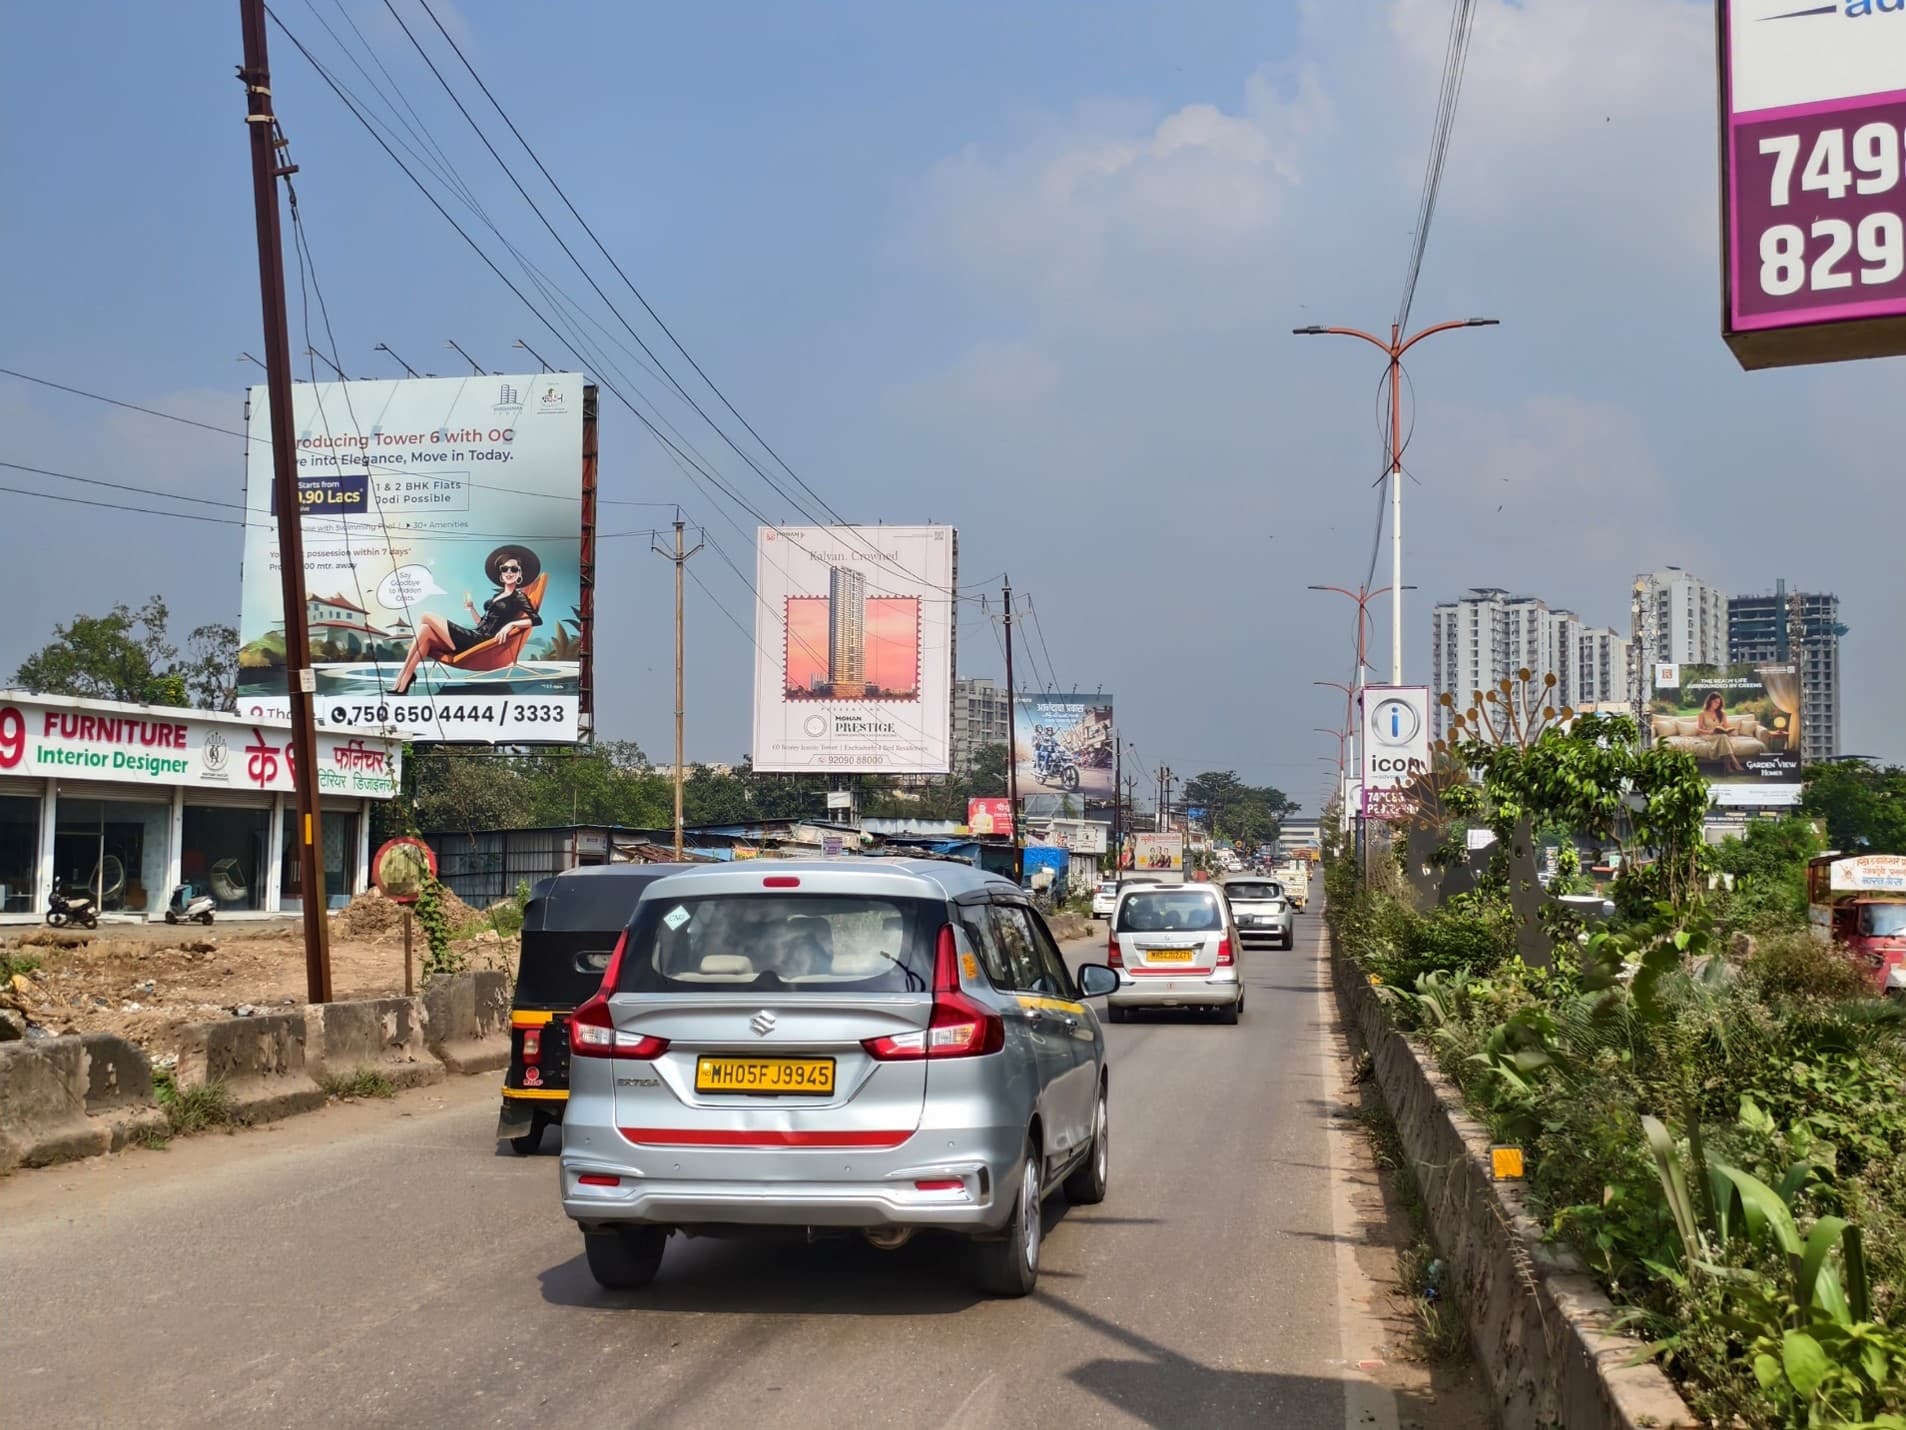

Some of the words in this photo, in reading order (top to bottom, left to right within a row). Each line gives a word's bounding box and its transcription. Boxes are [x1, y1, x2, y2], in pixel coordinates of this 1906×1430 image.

[374, 431, 425, 446] Tower
[430, 430, 440, 444] 6
[445, 428, 482, 443] with
[488, 428, 514, 442] OC
[311, 455, 337, 466] into
[341, 453, 407, 467] Elegance,
[411, 451, 448, 462] Move
[452, 449, 464, 461] in
[469, 449, 514, 462] Today.
[384, 483, 391, 491] &
[395, 483, 401, 491] 2
[405, 482, 429, 491] BHK
[433, 481, 461, 490] Flats
[404, 494, 451, 503] Possible
[429, 520, 469, 528] Amenities
[307, 549, 351, 558] possession
[353, 548, 380, 556] within
[852, 550, 898, 561] Crowned
[352, 706, 388, 723] 750
[394, 705, 433, 722] 650
[439, 705, 495, 722] 4444
[514, 705, 564, 722] 3333
[44, 712, 188, 748] FURNITURE
[835, 723, 895, 732] PRESTIGE
[37, 745, 109, 769] Interior
[113, 751, 188, 776] Designer
[711, 1065, 829, 1085] MH05FJ9945
